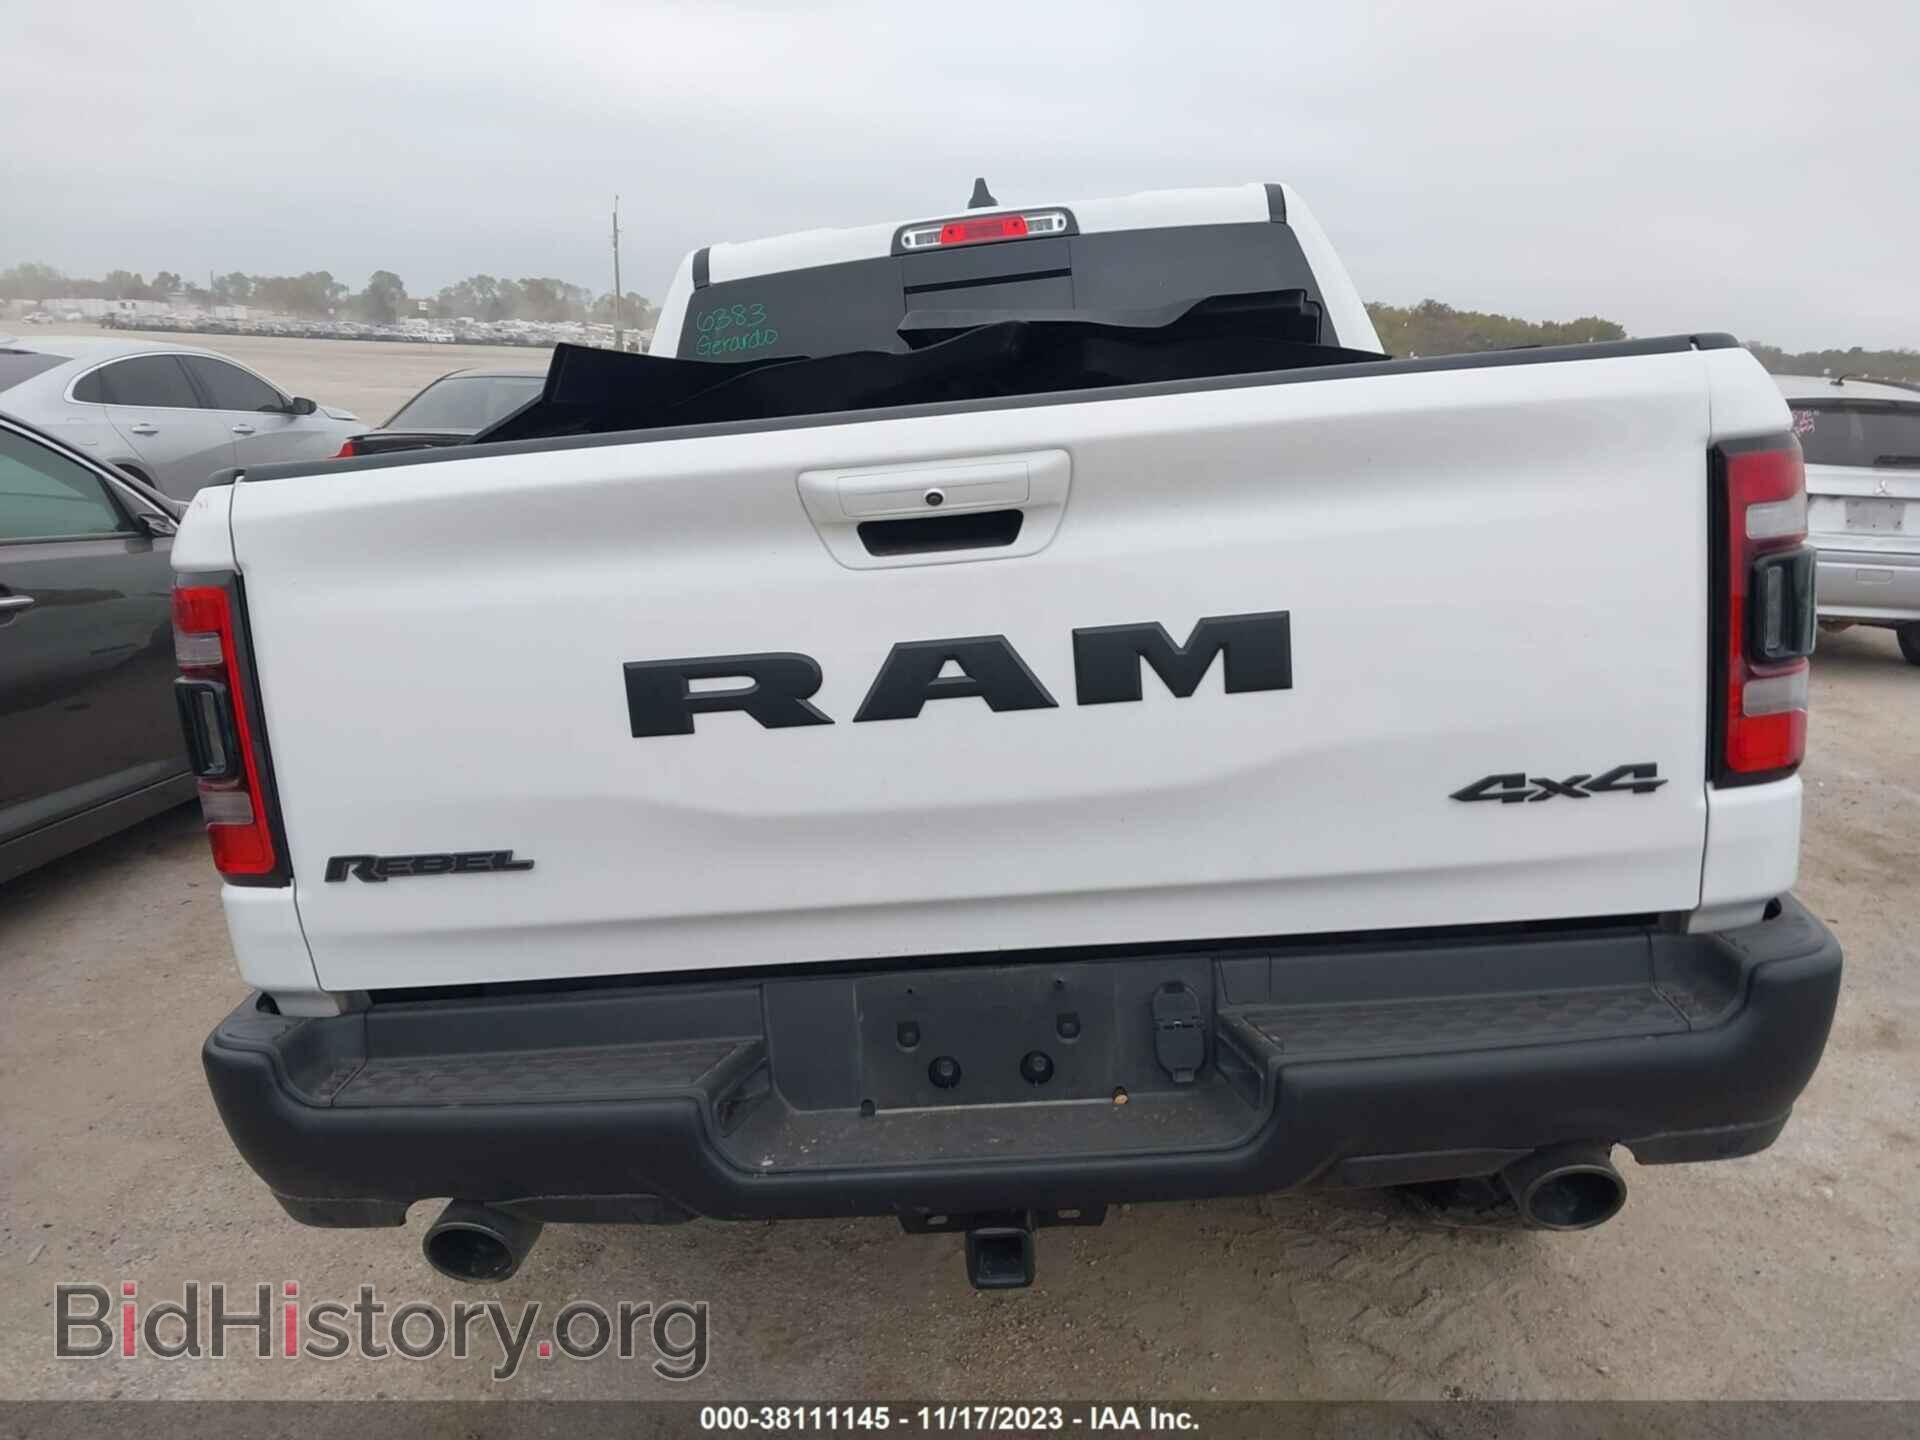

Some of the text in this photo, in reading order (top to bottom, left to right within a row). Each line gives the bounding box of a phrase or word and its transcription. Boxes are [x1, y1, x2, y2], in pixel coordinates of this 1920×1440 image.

[622, 610, 1293, 739] RAM
[1448, 762, 1669, 805] 4x4
[324, 849, 535, 883] REBEL
